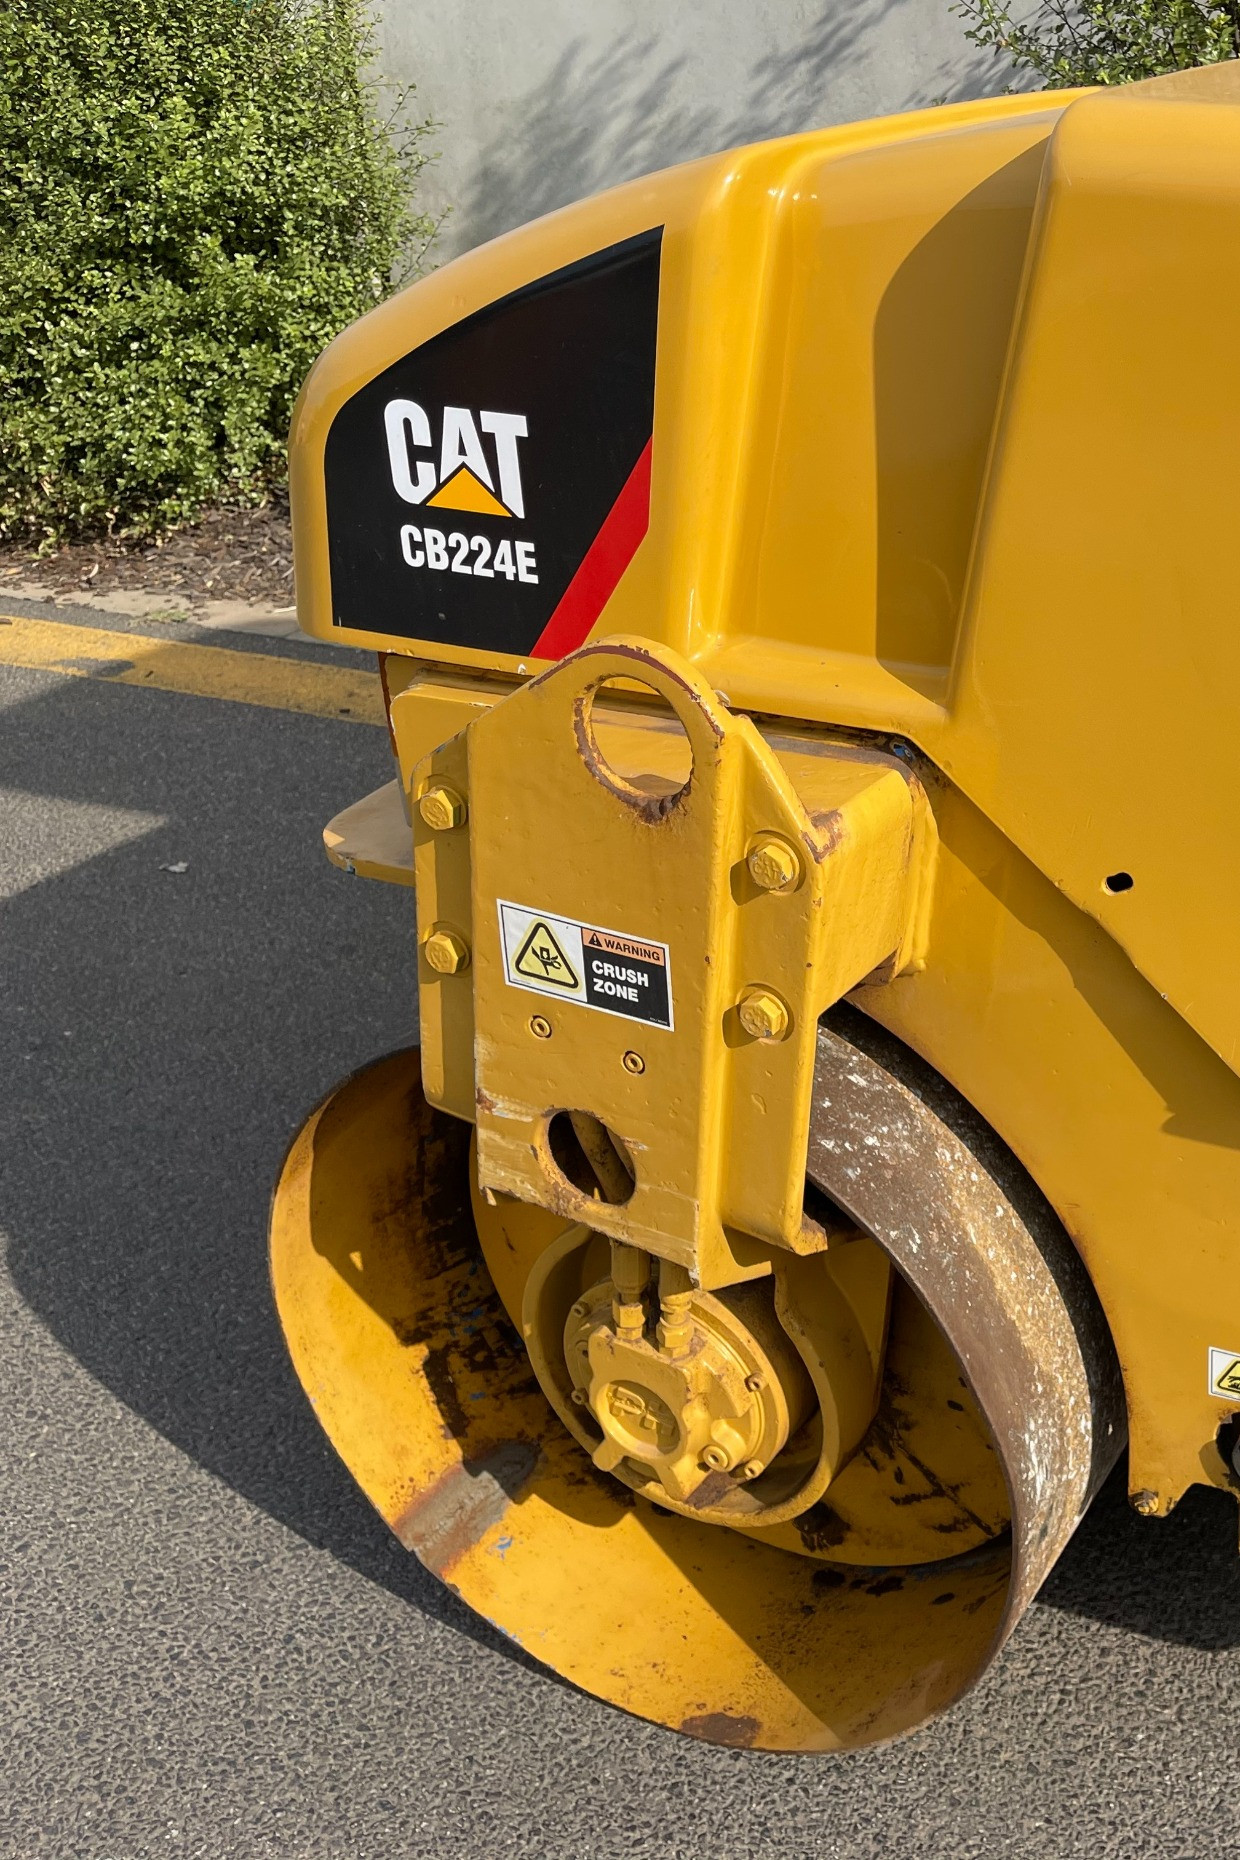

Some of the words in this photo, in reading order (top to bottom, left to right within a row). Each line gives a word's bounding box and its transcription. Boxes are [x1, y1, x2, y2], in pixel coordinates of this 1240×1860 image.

[384, 399, 528, 519] CAT
[400, 525, 539, 584] CB224E
[604, 938, 661, 962] WARNING
[591, 960, 649, 987] CRUSH
[592, 978, 639, 1003] ZONE
